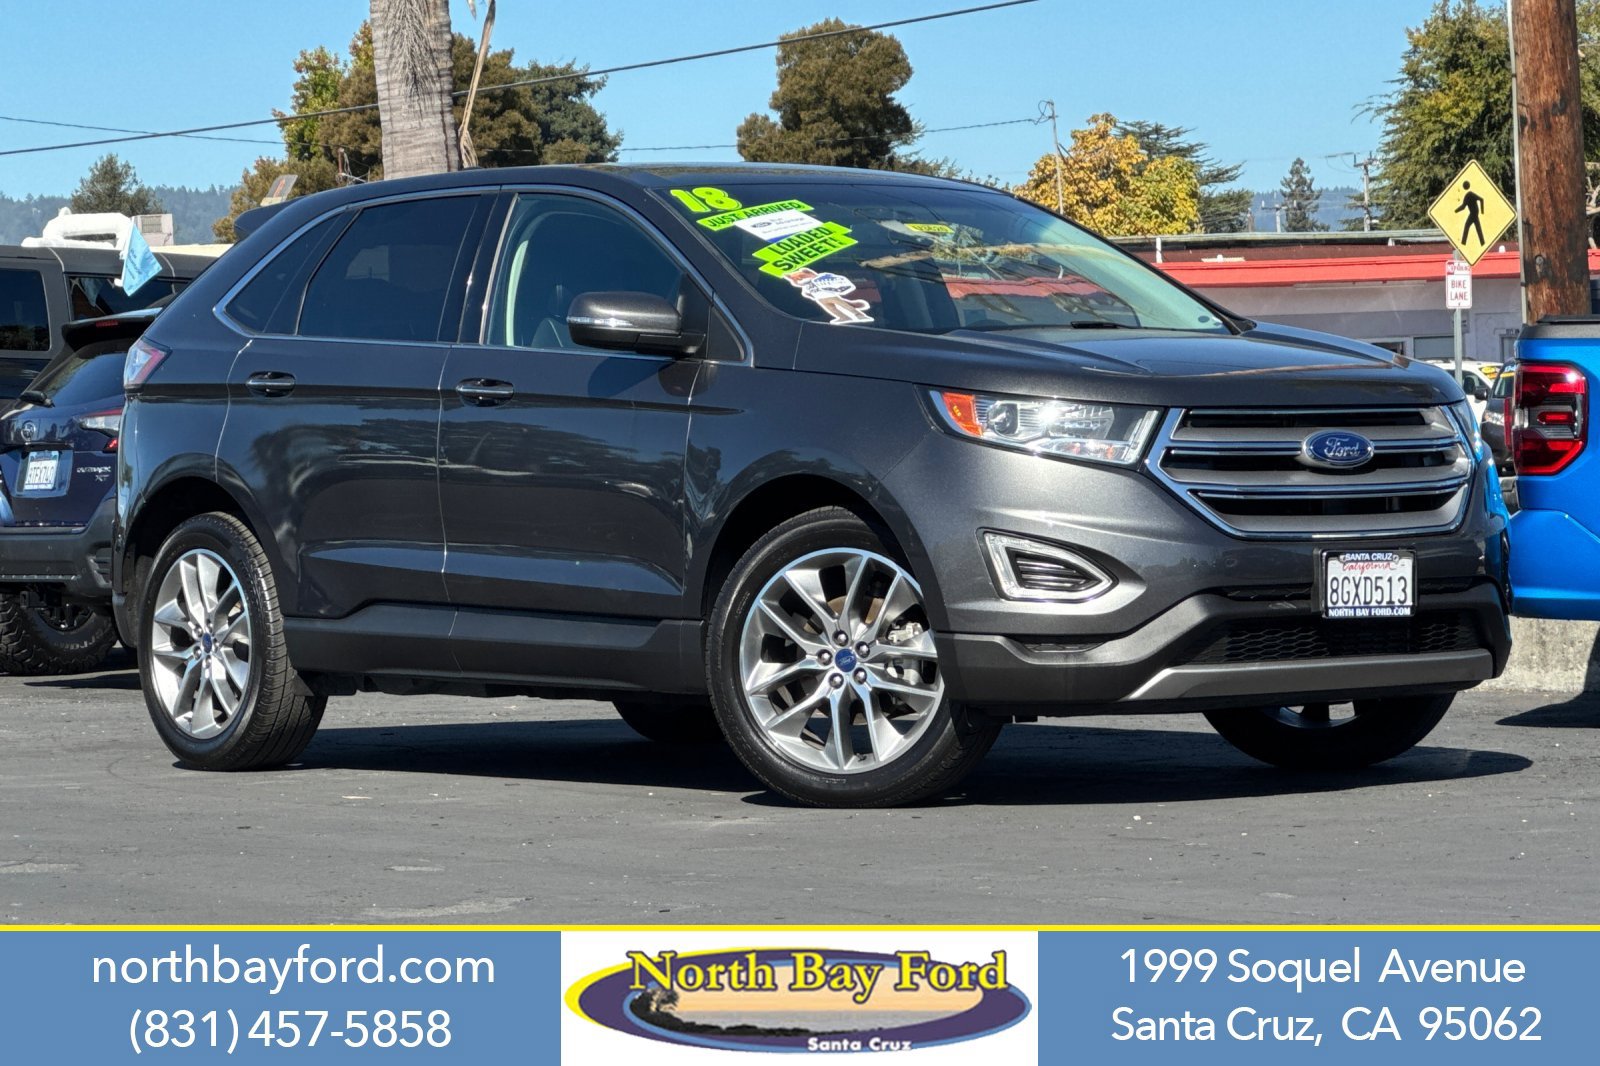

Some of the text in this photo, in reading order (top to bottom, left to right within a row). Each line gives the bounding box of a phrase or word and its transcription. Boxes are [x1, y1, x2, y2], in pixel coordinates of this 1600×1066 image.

[670, 187, 742, 212] 18
[707, 213, 738, 227] JUST
[768, 226, 833, 255] LOADED
[772, 237, 844, 271] SWEET!
[1451, 280, 1467, 288] BIKE
[1450, 292, 1468, 301] LANE
[1324, 437, 1361, 457] Ford
[1345, 553, 1370, 561] SANTA
[1342, 561, 1396, 575] California
[1330, 576, 1408, 606] 8GXD513
[1328, 607, 1411, 617] NORTH BAY FORD.COM
